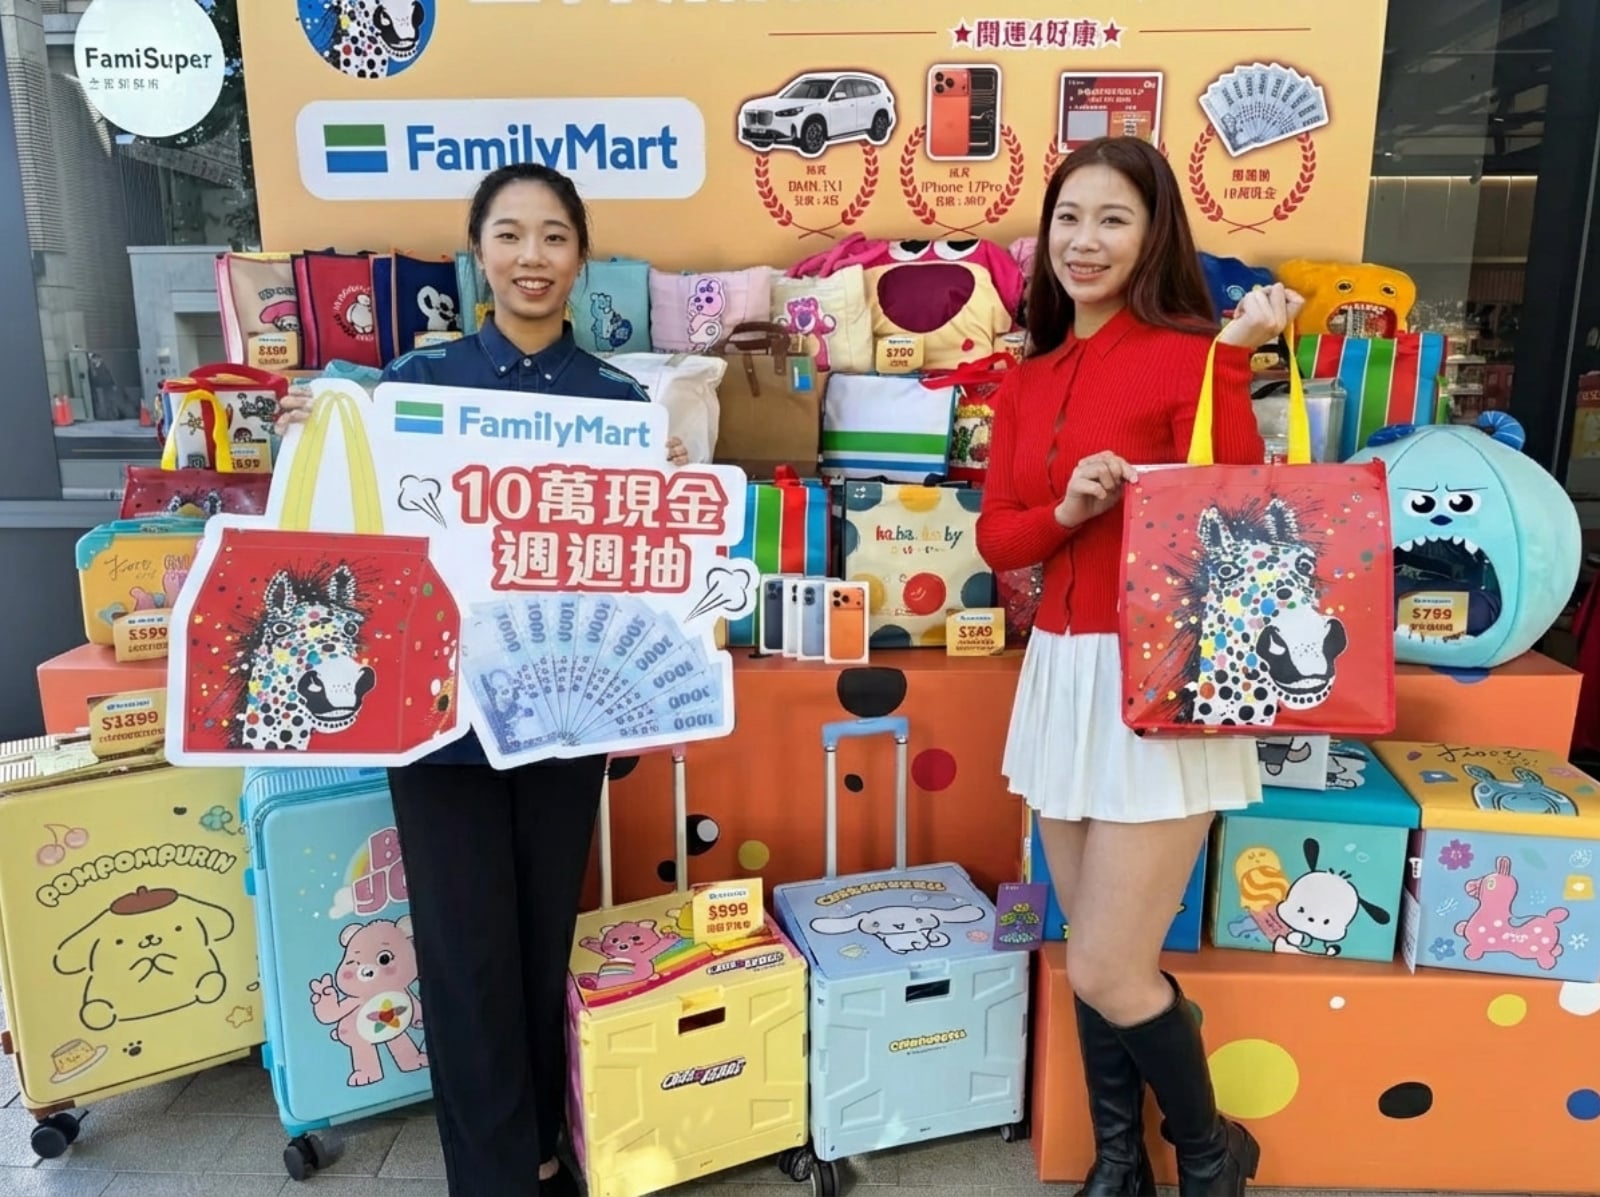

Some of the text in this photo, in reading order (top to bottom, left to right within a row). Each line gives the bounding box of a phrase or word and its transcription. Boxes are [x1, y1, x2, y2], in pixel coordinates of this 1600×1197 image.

[85, 47, 212, 75] FamiSuper
[921, 180, 963, 193] iPhone
[458, 406, 651, 448] FamilyMart
[455, 466, 724, 533] 10萬現金
[498, 530, 692, 590] 週週抽
[36, 843, 238, 907] POMPOMPURIN
